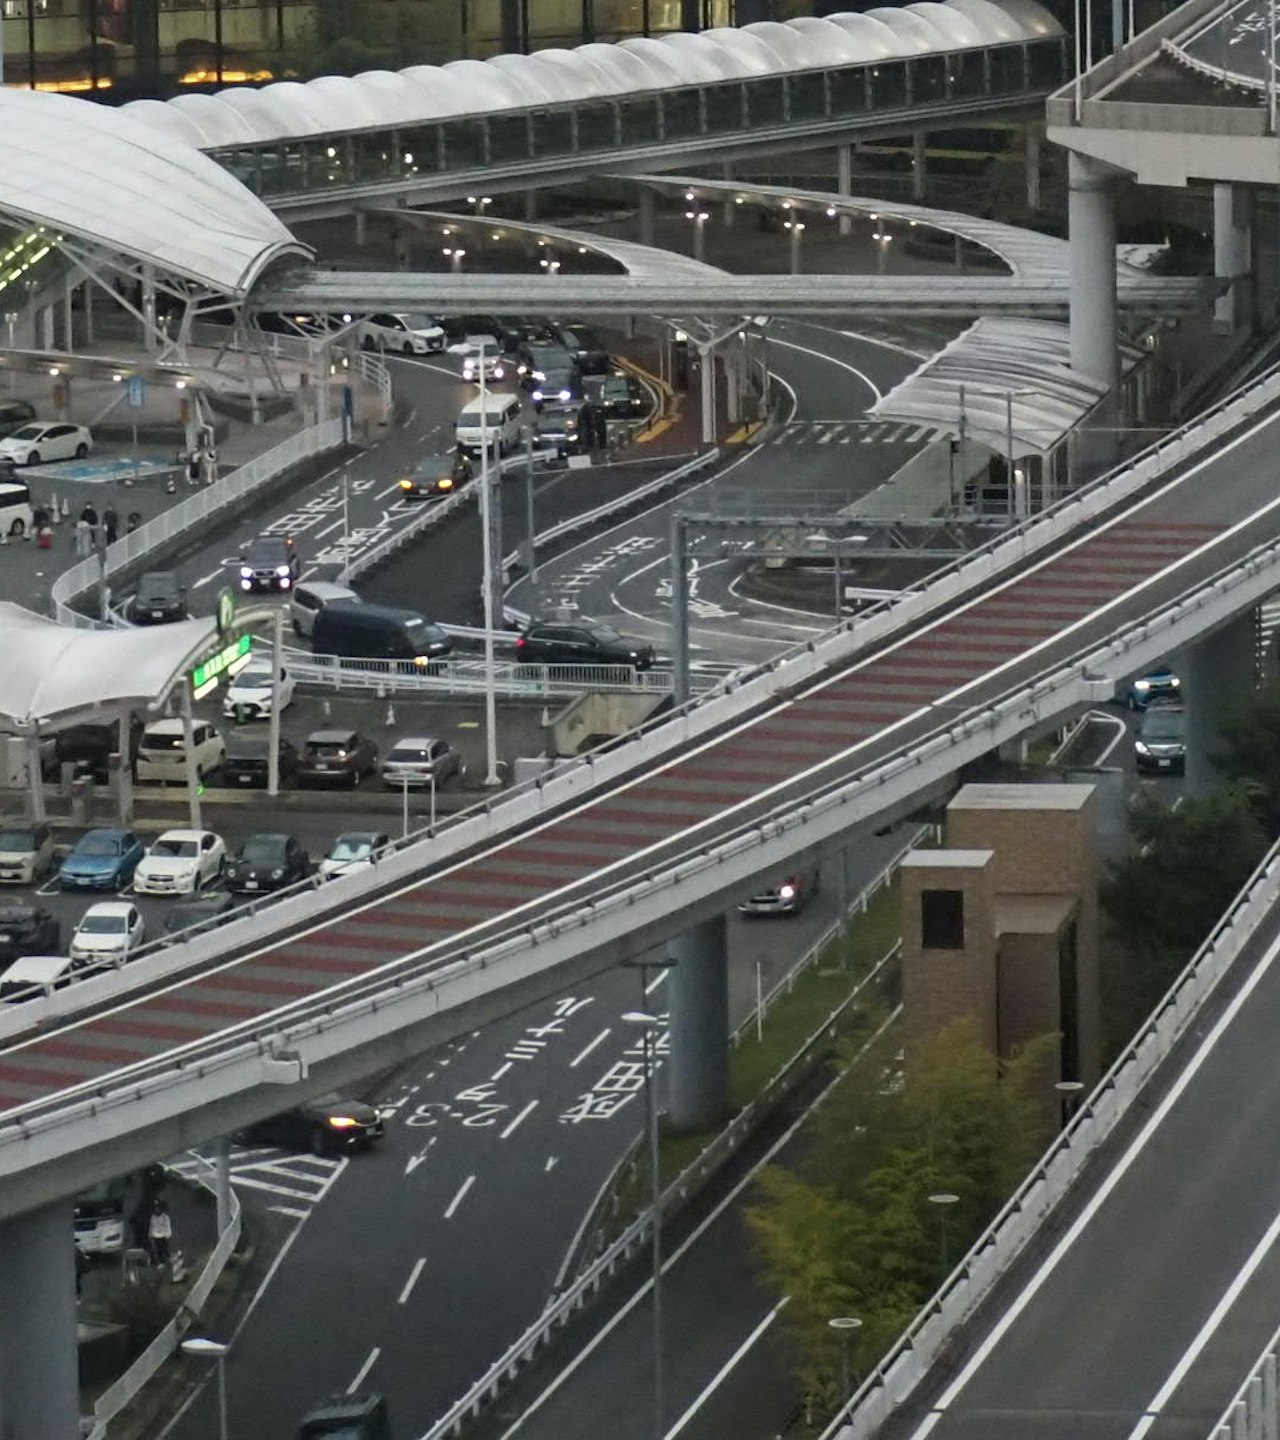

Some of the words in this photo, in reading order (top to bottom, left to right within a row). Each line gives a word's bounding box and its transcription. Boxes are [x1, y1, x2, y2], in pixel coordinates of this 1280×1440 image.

[454, 996, 596, 1102] ターミナル
